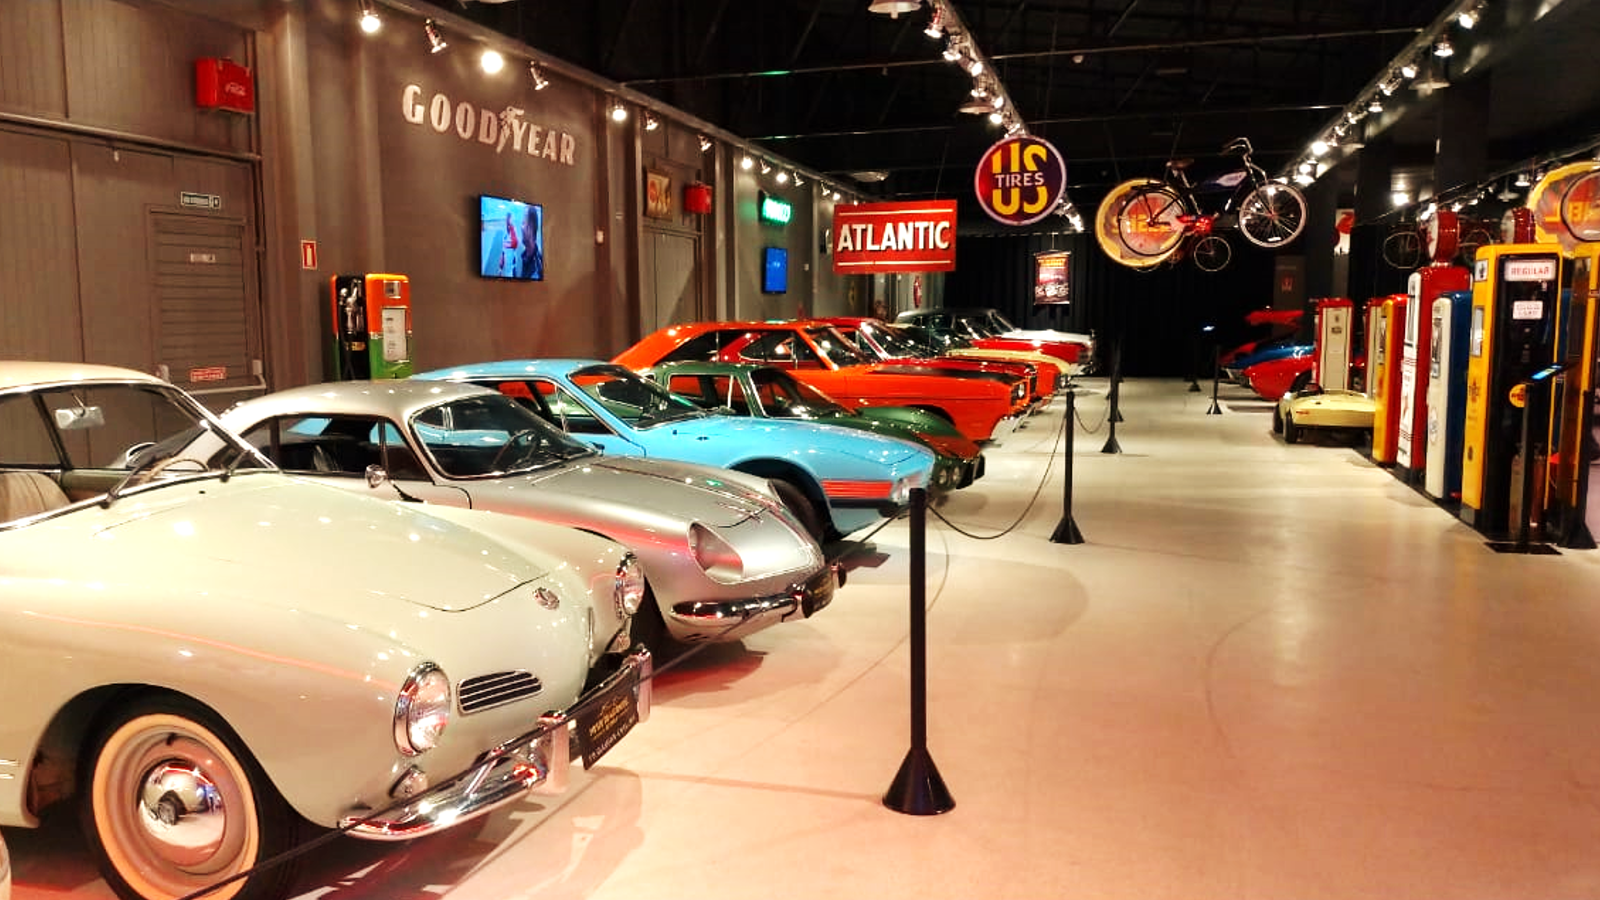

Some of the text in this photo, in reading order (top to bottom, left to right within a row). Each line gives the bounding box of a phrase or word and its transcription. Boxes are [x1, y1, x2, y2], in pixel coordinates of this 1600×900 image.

[402, 84, 576, 166] GOODYEAR
[992, 142, 1048, 215] US
[994, 171, 1045, 188] TIRES
[837, 221, 950, 252] ATLANTIC
